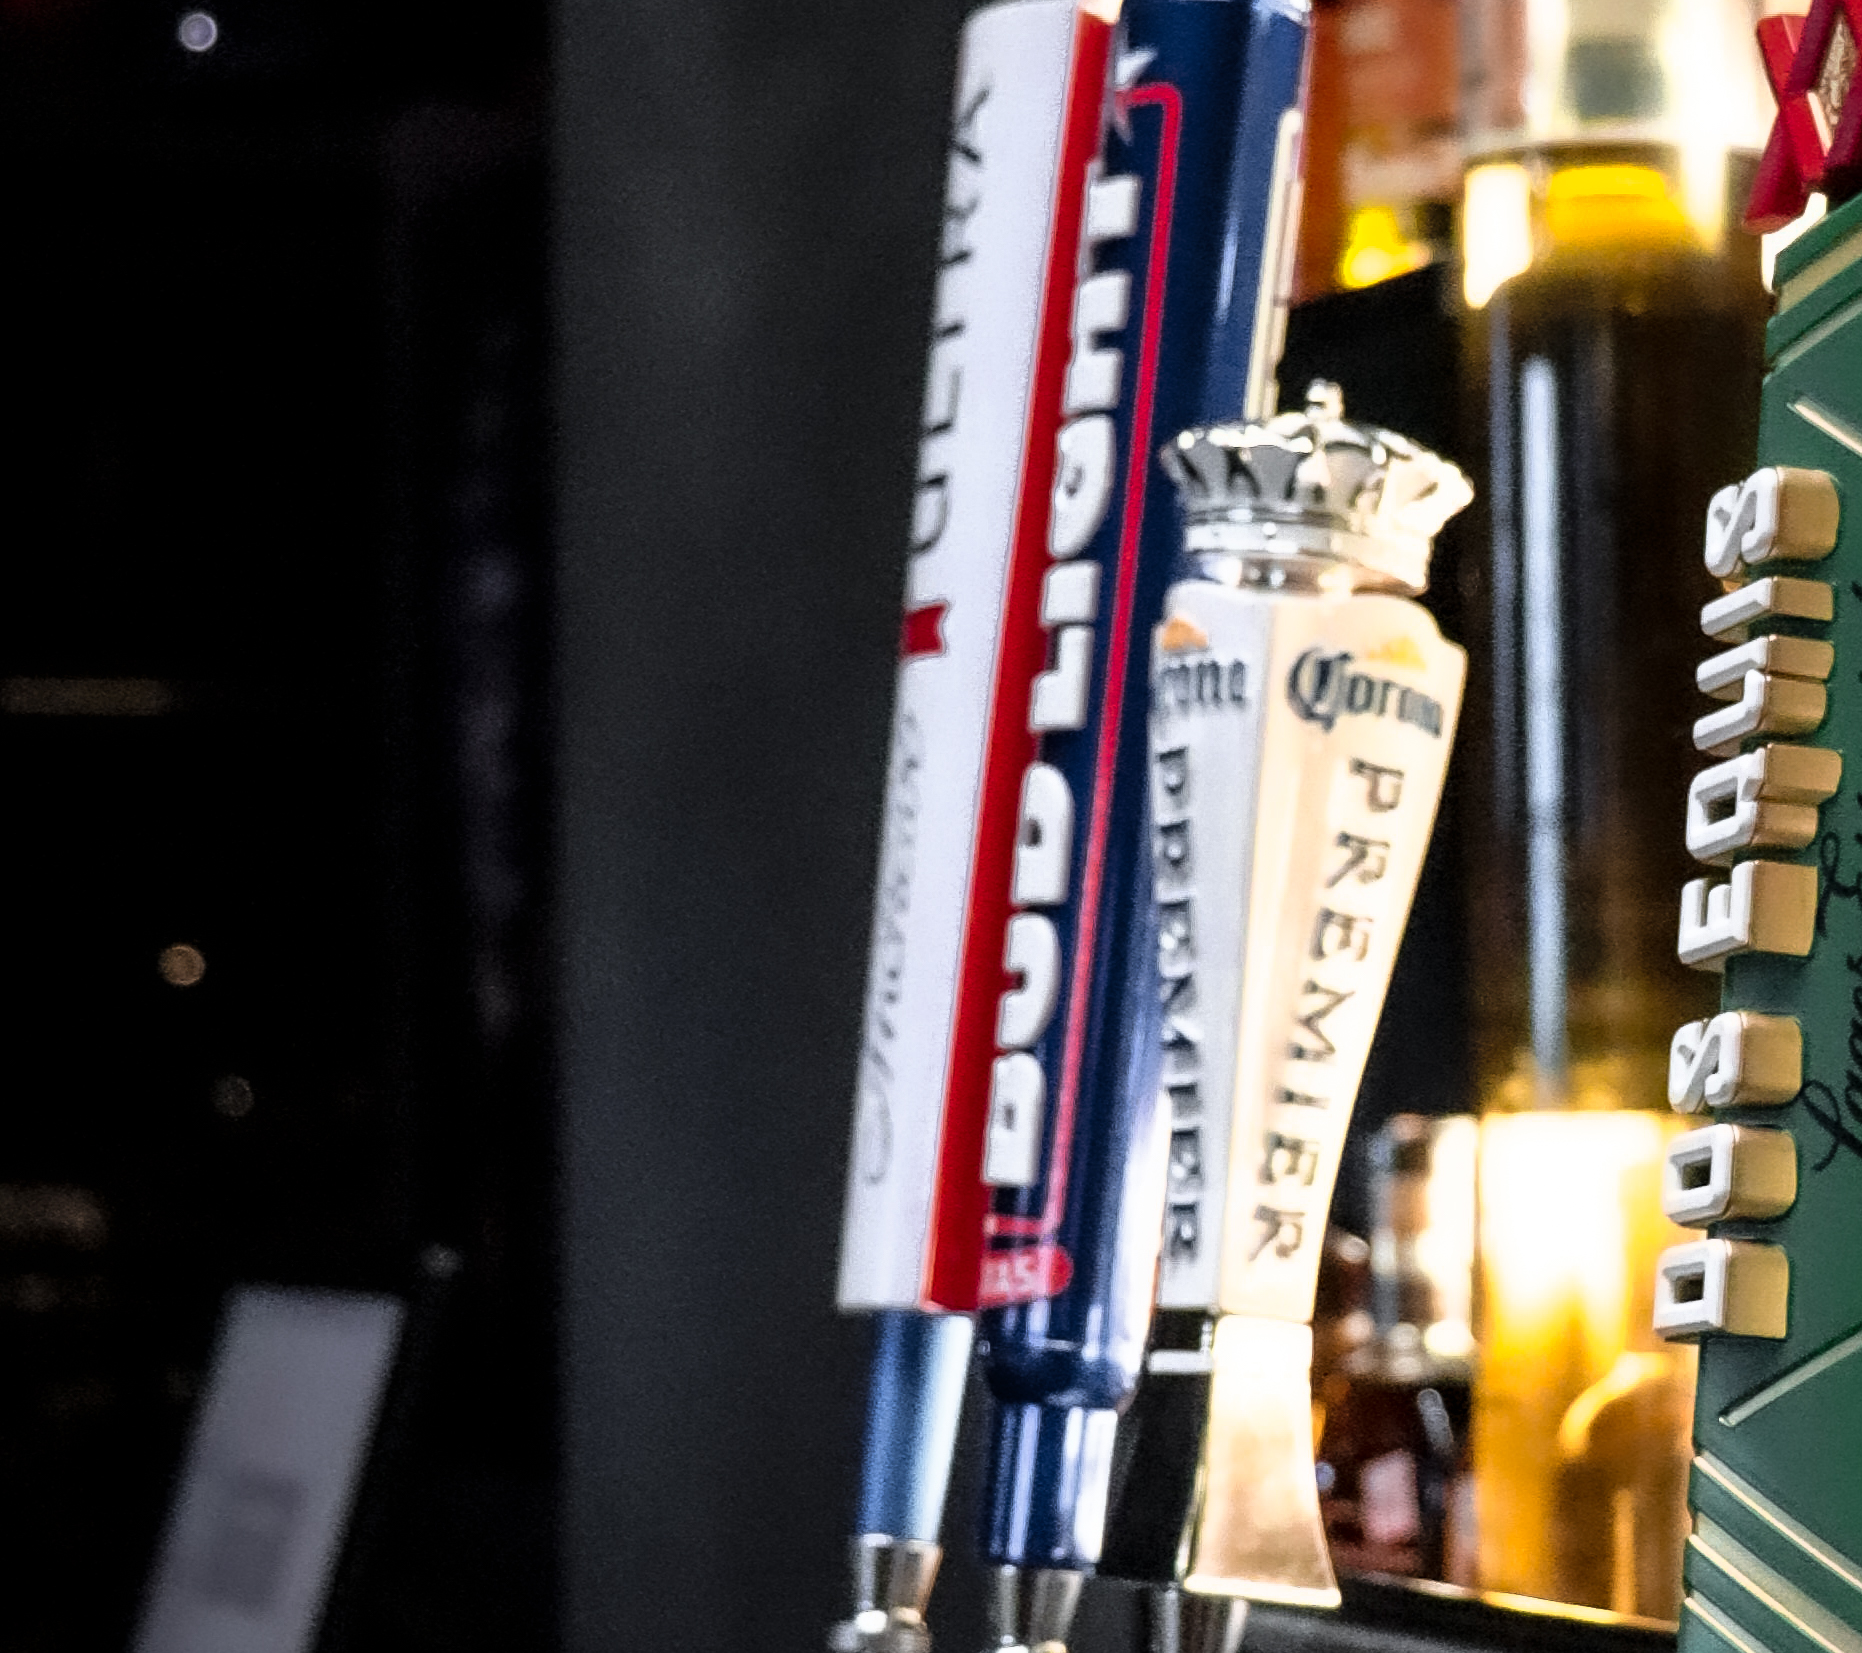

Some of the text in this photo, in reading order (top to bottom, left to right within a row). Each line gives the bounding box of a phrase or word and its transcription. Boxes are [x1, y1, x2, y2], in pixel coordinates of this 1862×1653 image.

[1249, 756, 1406, 1263] PREMIER
[1652, 464, 1834, 1343] DOS EQUIS
